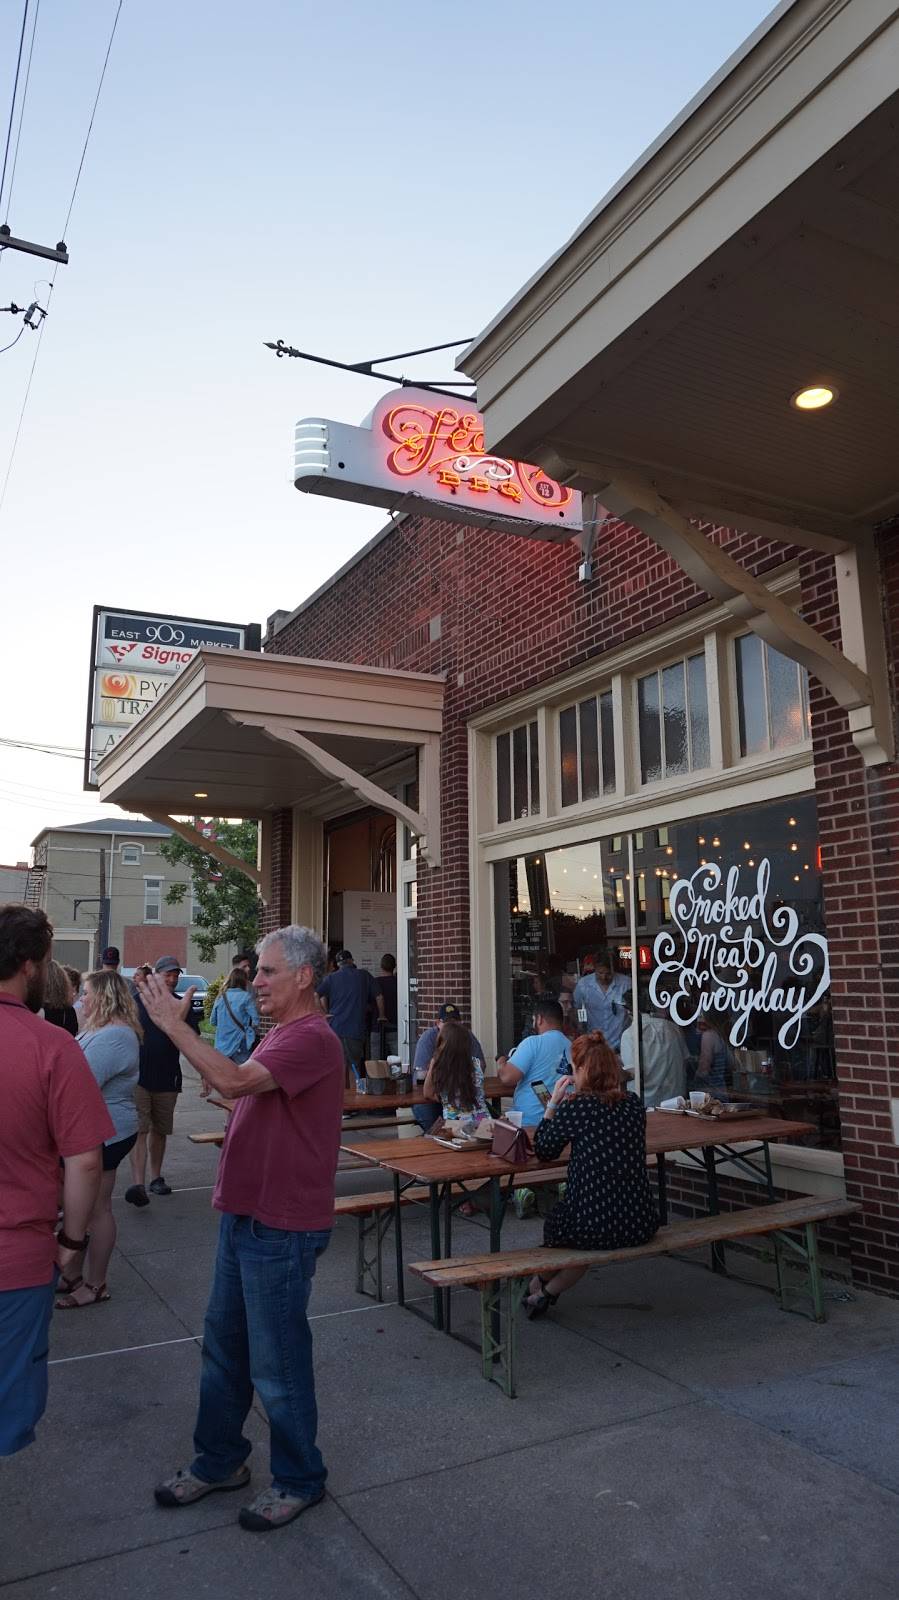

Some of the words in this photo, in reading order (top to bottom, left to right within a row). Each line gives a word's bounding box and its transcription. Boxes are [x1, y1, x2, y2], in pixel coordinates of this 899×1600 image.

[437, 469, 523, 503] BBQ
[111, 629, 140, 639] EAST
[146, 624, 185, 646] 909
[668, 857, 799, 946] Smoked
[687, 925, 765, 988] Meat
[649, 933, 832, 1050] Everyday
